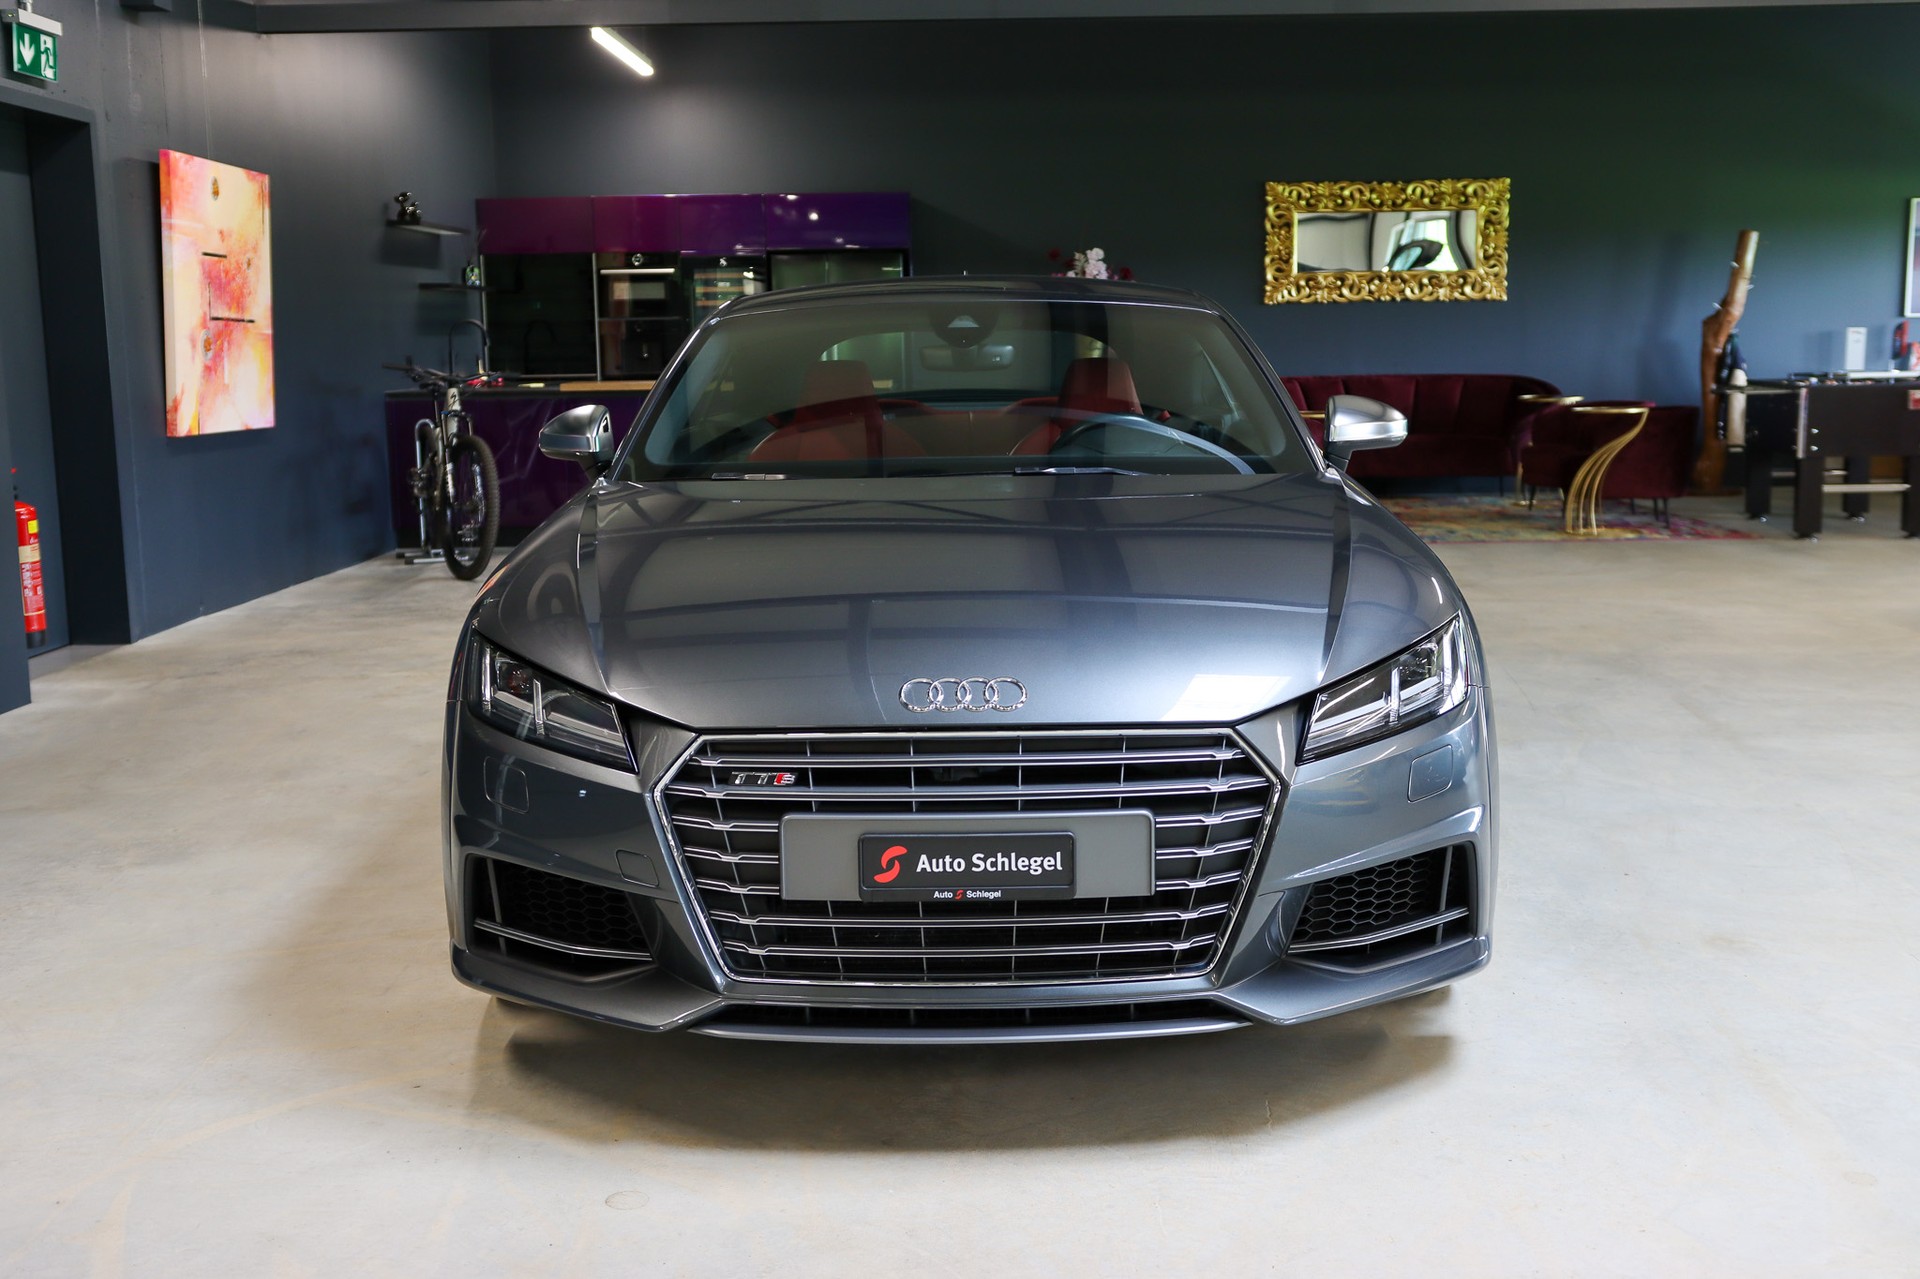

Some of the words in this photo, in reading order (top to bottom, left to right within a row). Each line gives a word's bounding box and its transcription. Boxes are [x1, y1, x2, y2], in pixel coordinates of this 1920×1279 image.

[731, 771, 797, 786] TTS
[916, 853, 966, 873] Auto
[971, 851, 1063, 876] Schlegel
[933, 890, 954, 899] Auto
[966, 889, 1002, 900] Schlegel
